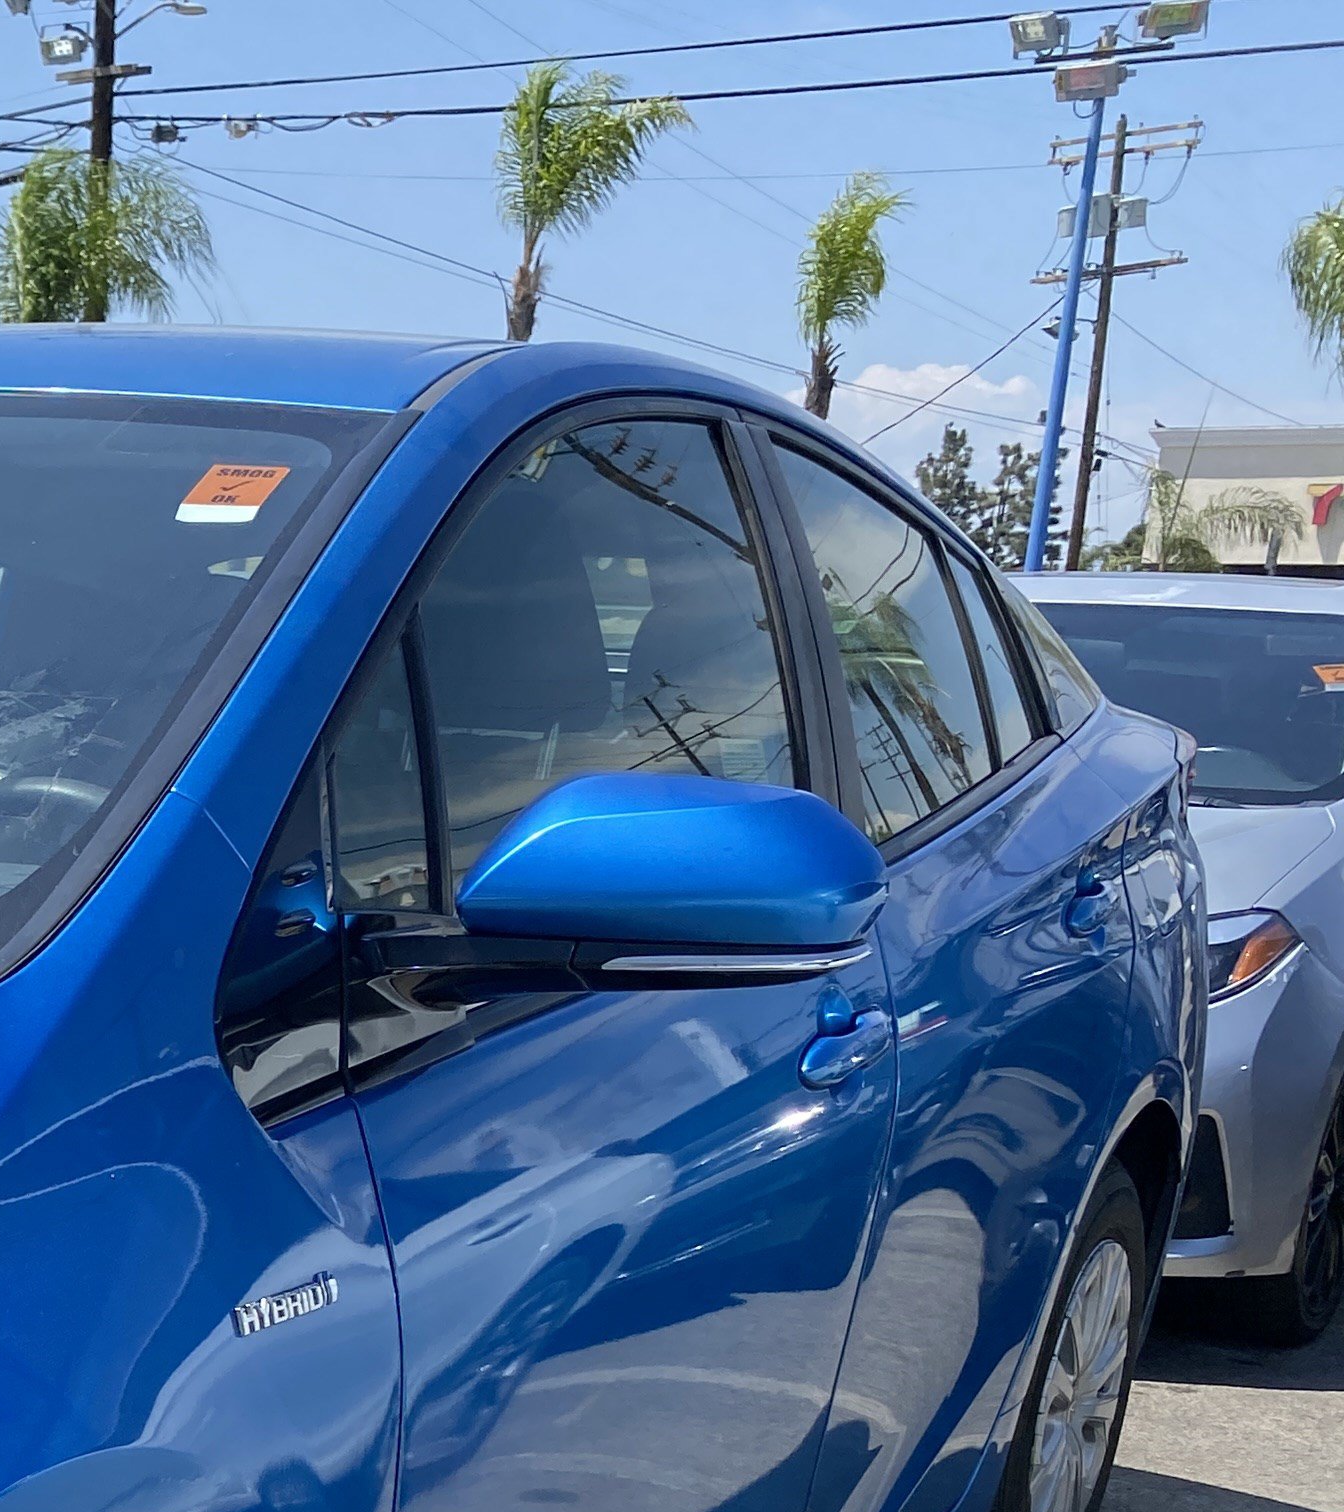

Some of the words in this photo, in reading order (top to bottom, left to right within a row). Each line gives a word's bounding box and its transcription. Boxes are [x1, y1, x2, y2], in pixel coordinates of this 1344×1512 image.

[216, 468, 277, 478] SMOG
[211, 495, 240, 503] OK
[234, 1282, 324, 1337] HYBRID
